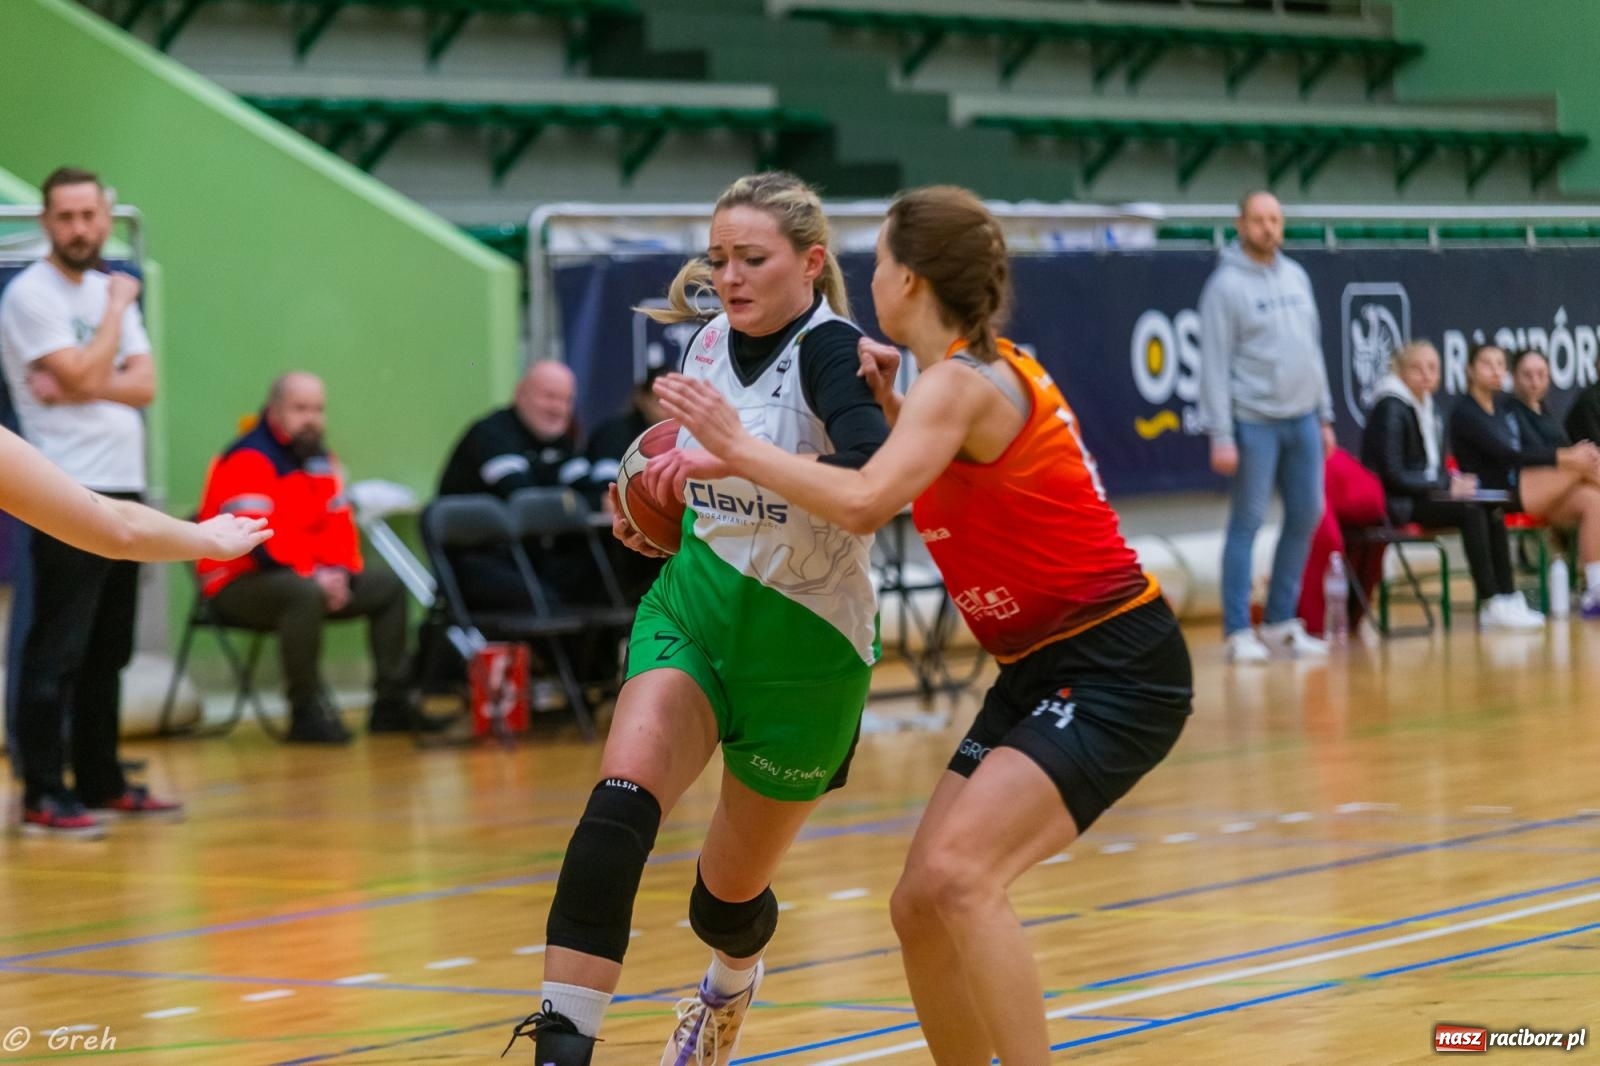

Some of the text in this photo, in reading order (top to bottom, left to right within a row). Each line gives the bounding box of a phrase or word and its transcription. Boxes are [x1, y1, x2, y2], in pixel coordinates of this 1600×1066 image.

[689, 482, 788, 525] Clavis
[654, 630, 692, 661] 7
[605, 778, 639, 792] ALLSIX
